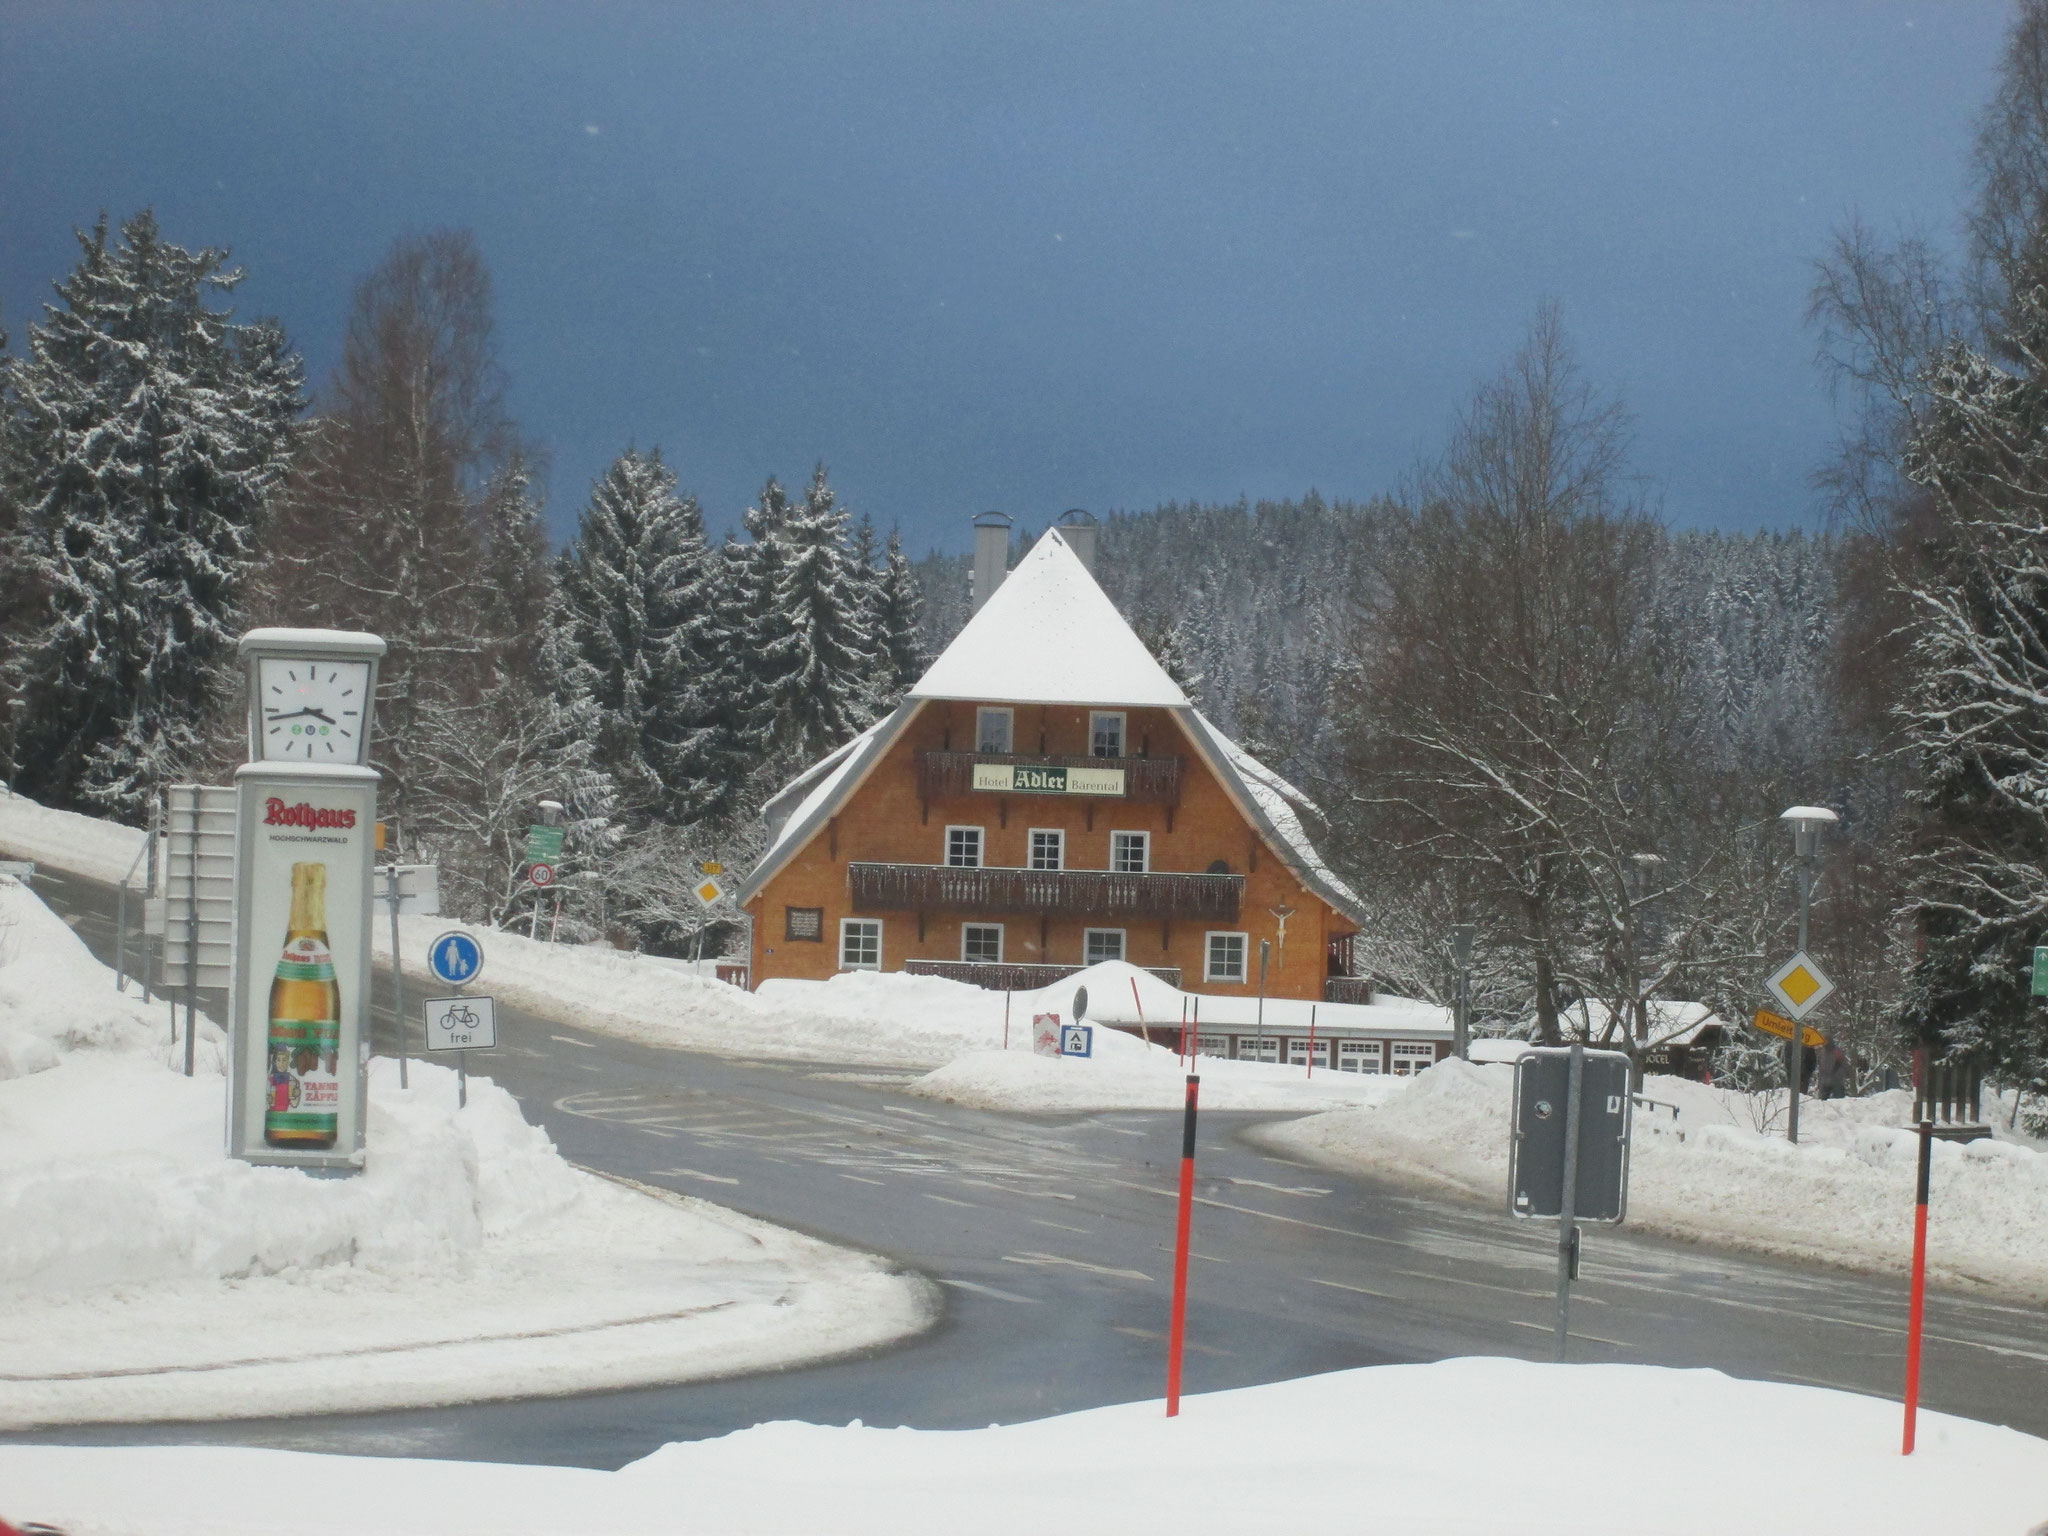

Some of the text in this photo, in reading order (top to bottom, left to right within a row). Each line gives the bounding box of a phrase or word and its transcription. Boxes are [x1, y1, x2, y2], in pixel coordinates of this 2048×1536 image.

[979, 776, 1008, 787] Hotel
[1015, 770, 1065, 789] Adler
[263, 797, 356, 832] Rothaus
[269, 834, 348, 844] HOCHSCHWARZWALD
[535, 870, 548, 880] 60
[450, 1032, 472, 1043] frei
[1762, 1016, 1811, 1044] Umleitg
